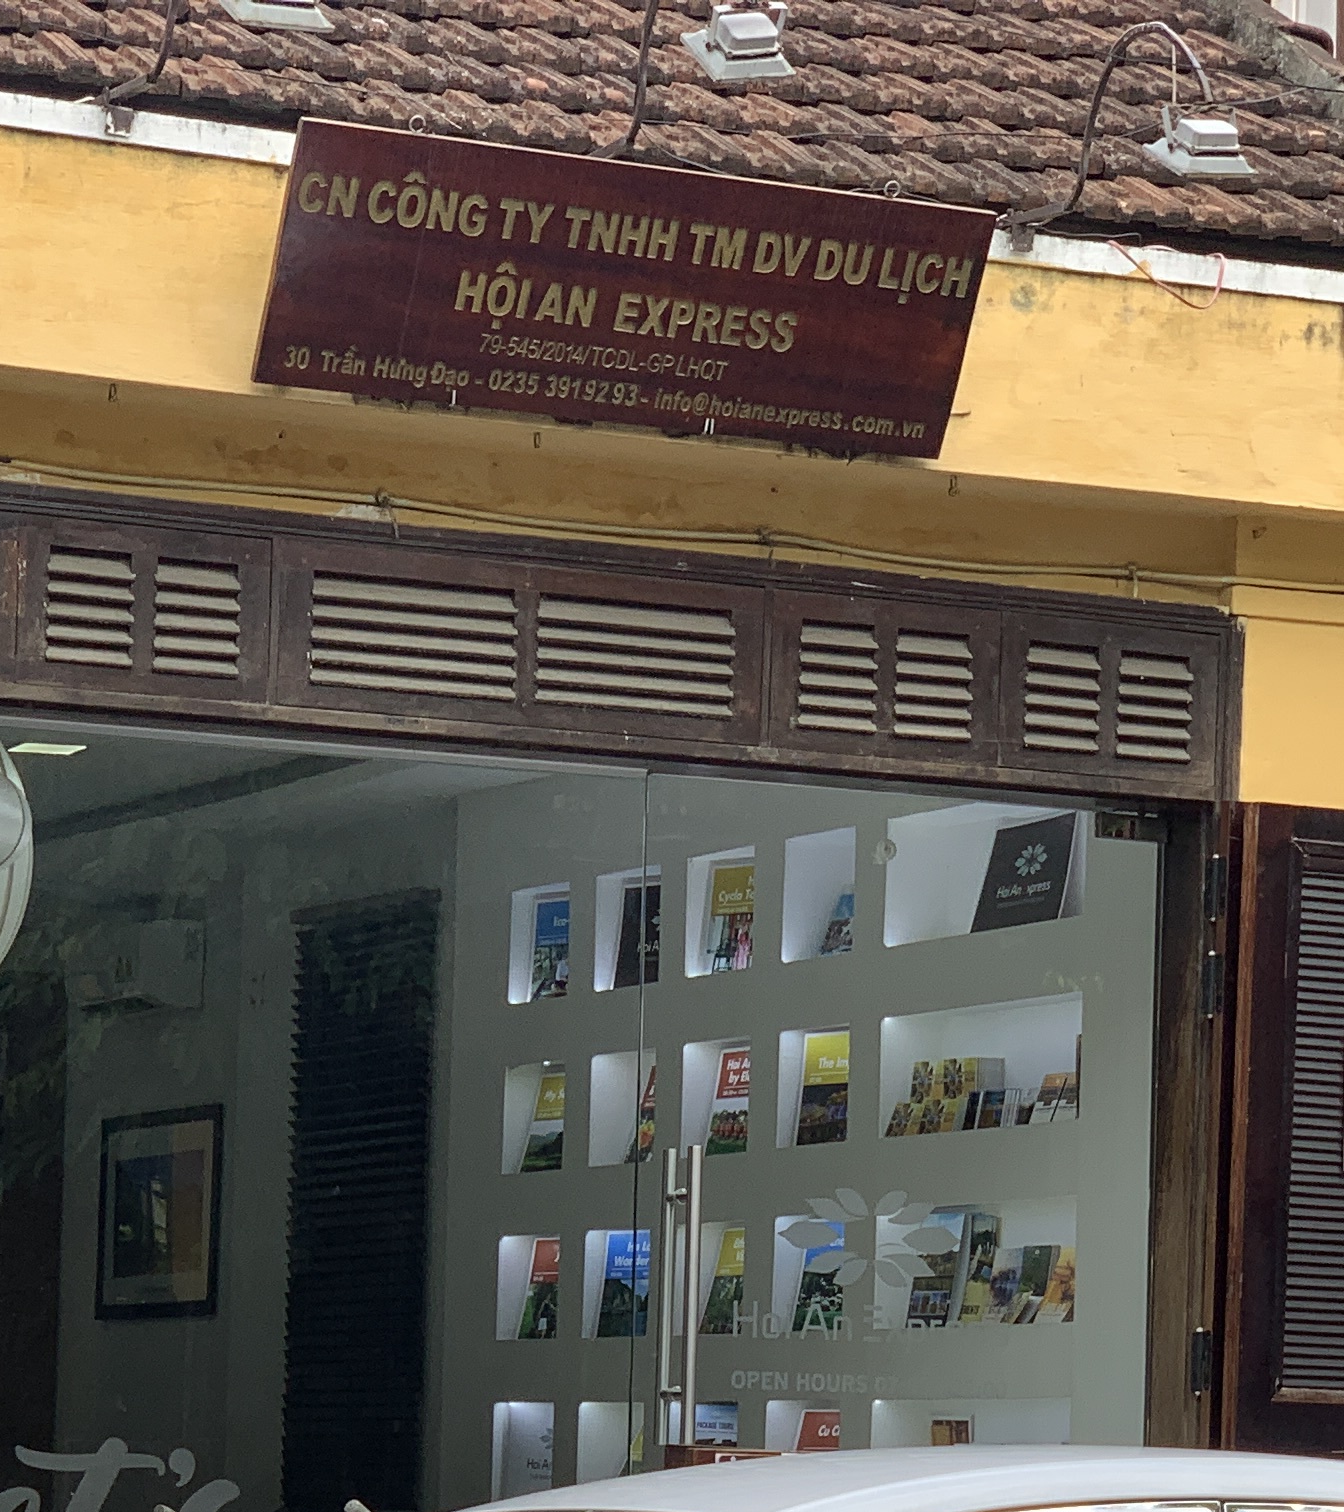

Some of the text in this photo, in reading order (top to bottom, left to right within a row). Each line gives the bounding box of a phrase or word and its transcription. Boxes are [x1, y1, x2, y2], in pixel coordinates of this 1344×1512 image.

[299, 170, 973, 304] CN CÔNG TY TNHH TM DV DU LỊCH
[454, 261, 799, 353] HỘI AN EXPRESS
[284, 345, 310, 370] 30
[321, 344, 366, 376] Trần
[373, 355, 425, 388] Hưng
[430, 361, 471, 392] Đạo
[488, 369, 538, 396] 0235
[654, 388, 928, 439] info@hoianexpress.com.vn
[799, 1300, 853, 1341] An
[731, 1370, 788, 1391] OPEN
[796, 1372, 868, 1393] HOURS
